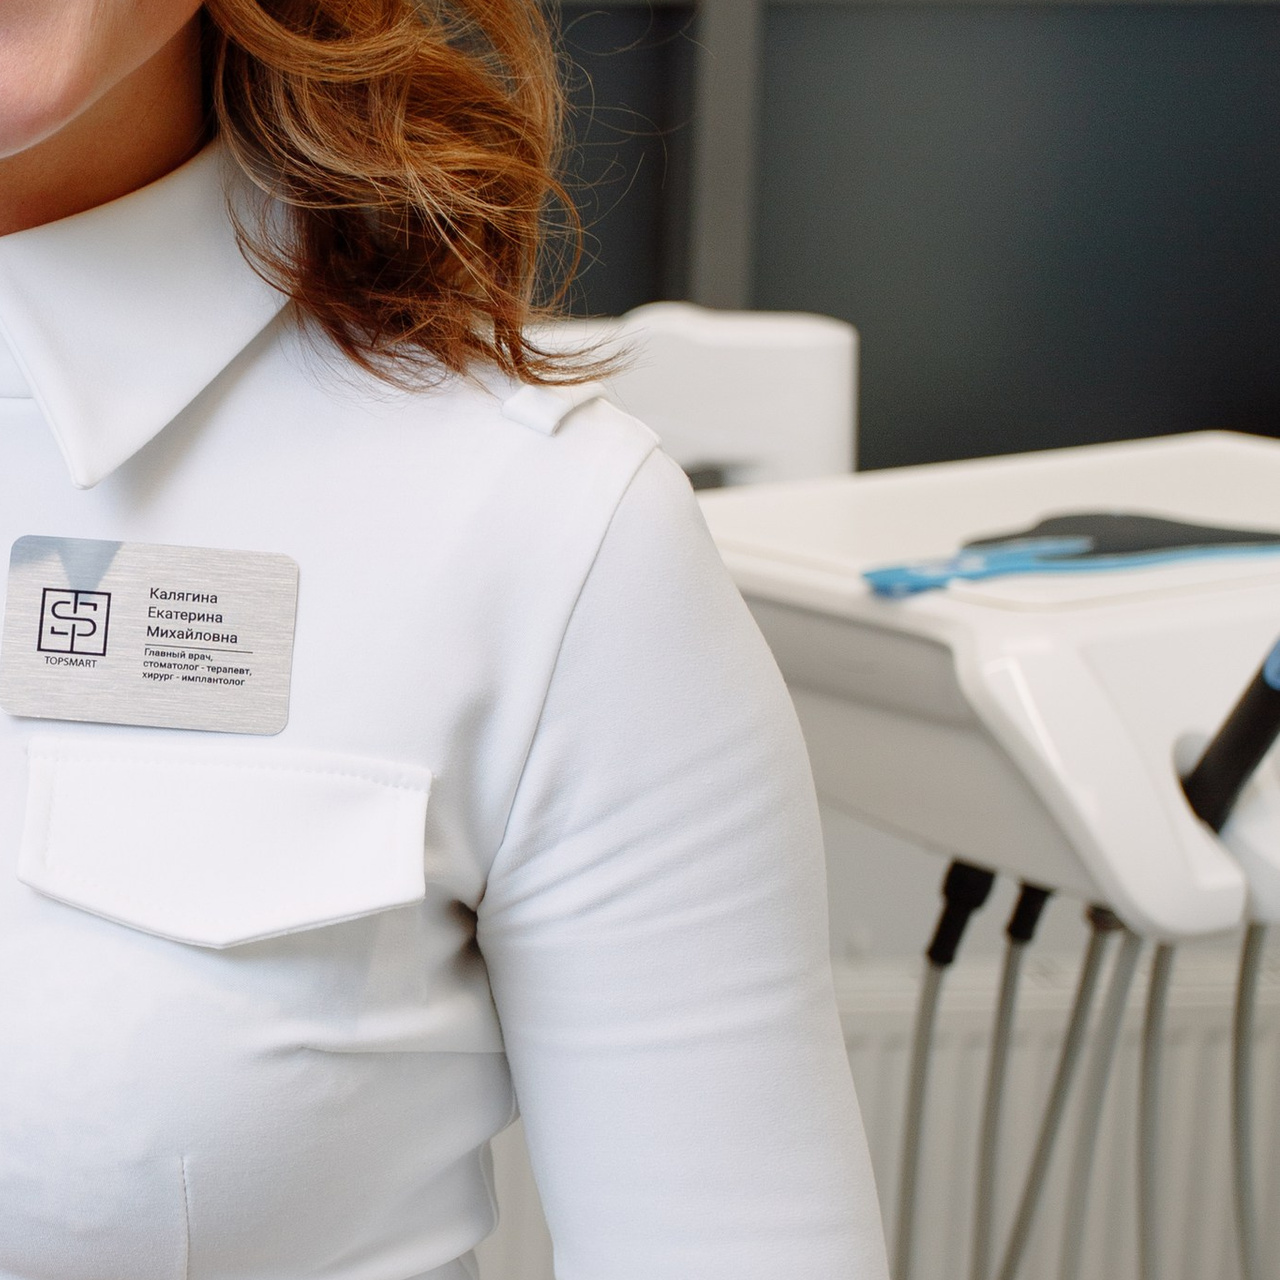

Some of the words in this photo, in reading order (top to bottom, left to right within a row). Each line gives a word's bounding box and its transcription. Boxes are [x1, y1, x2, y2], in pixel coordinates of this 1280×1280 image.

[149, 587, 218, 604] Калягина
[148, 606, 223, 623] Екатерина
[146, 625, 238, 644] Михайловна
[44, 656, 98, 668] TOPSMART
[144, 647, 186, 659] Главный
[188, 651, 213, 662] врач,
[143, 660, 199, 671] стоматолог
[206, 665, 252, 676] терапевт,
[142, 671, 174, 682] хирург
[181, 675, 246, 686] имплантолог
